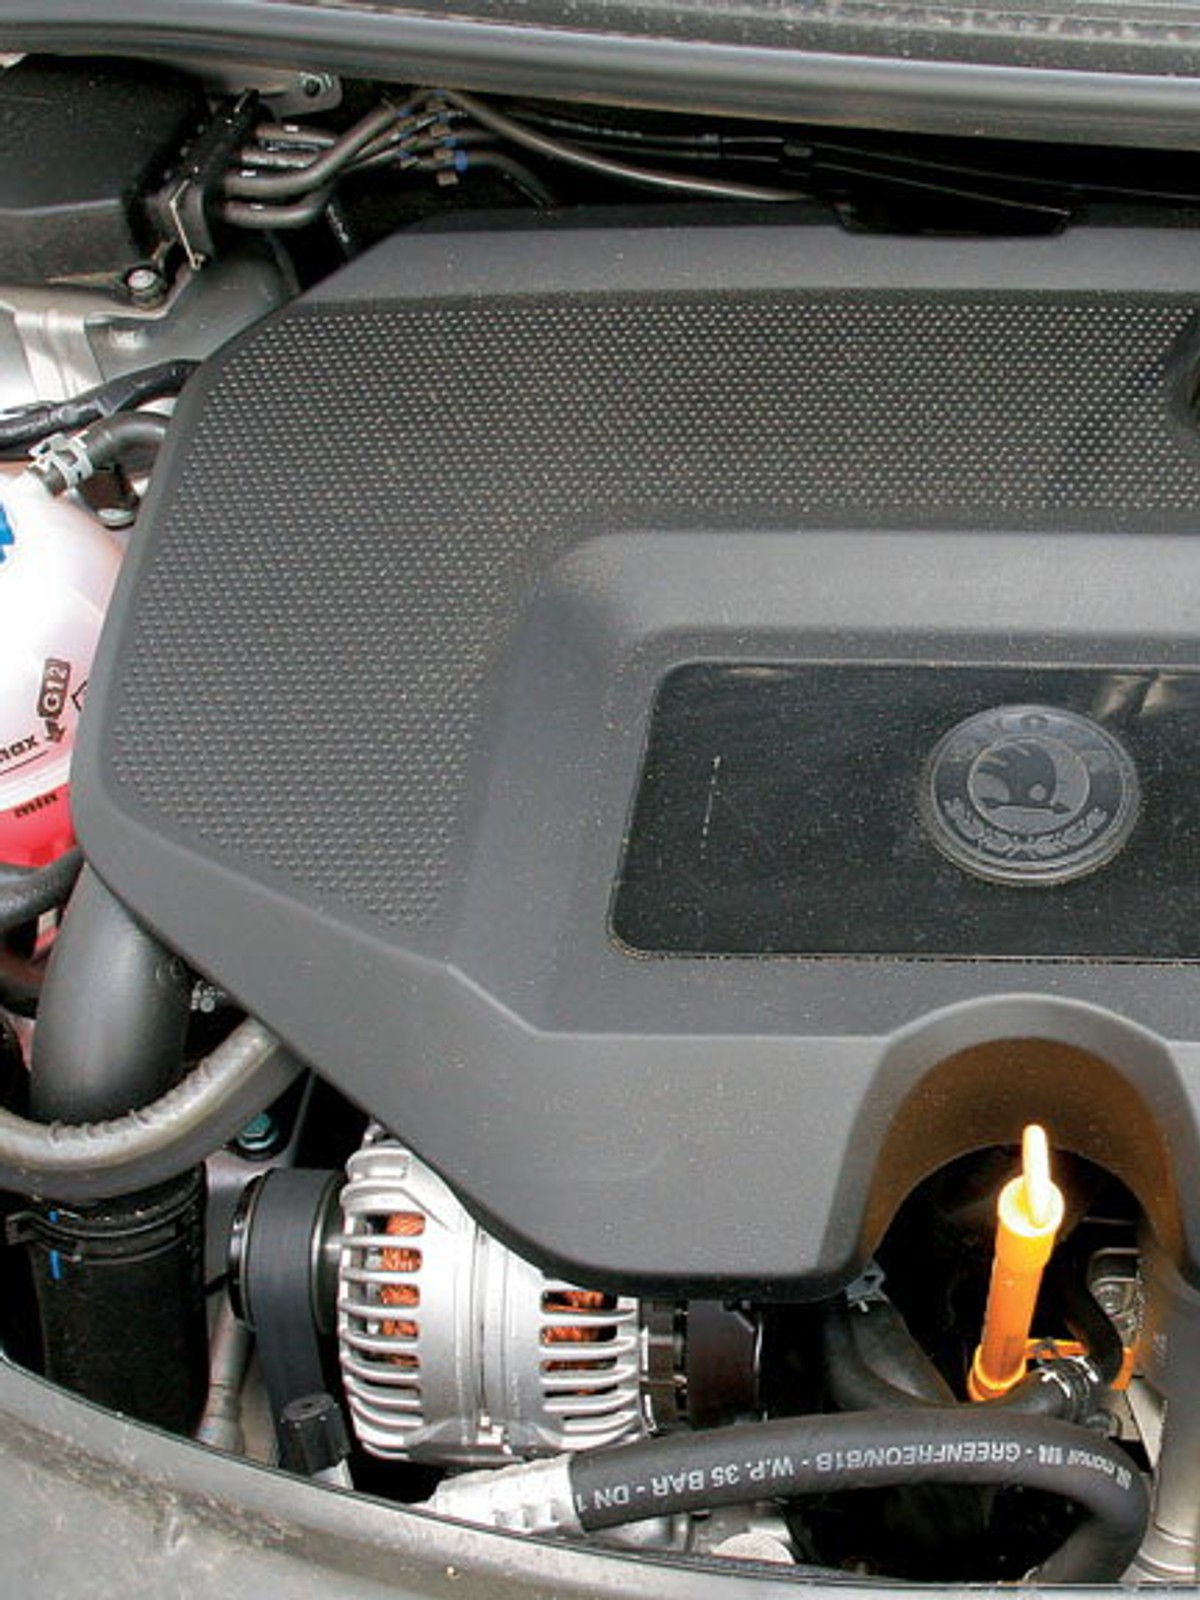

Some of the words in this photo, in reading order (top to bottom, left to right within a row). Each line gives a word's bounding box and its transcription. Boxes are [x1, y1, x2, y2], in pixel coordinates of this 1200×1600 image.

[43, 665, 68, 712] G12
[651, 1469, 705, 1496] BAR
[710, 1463, 740, 1487] 35
[593, 1485, 630, 1510] DN
